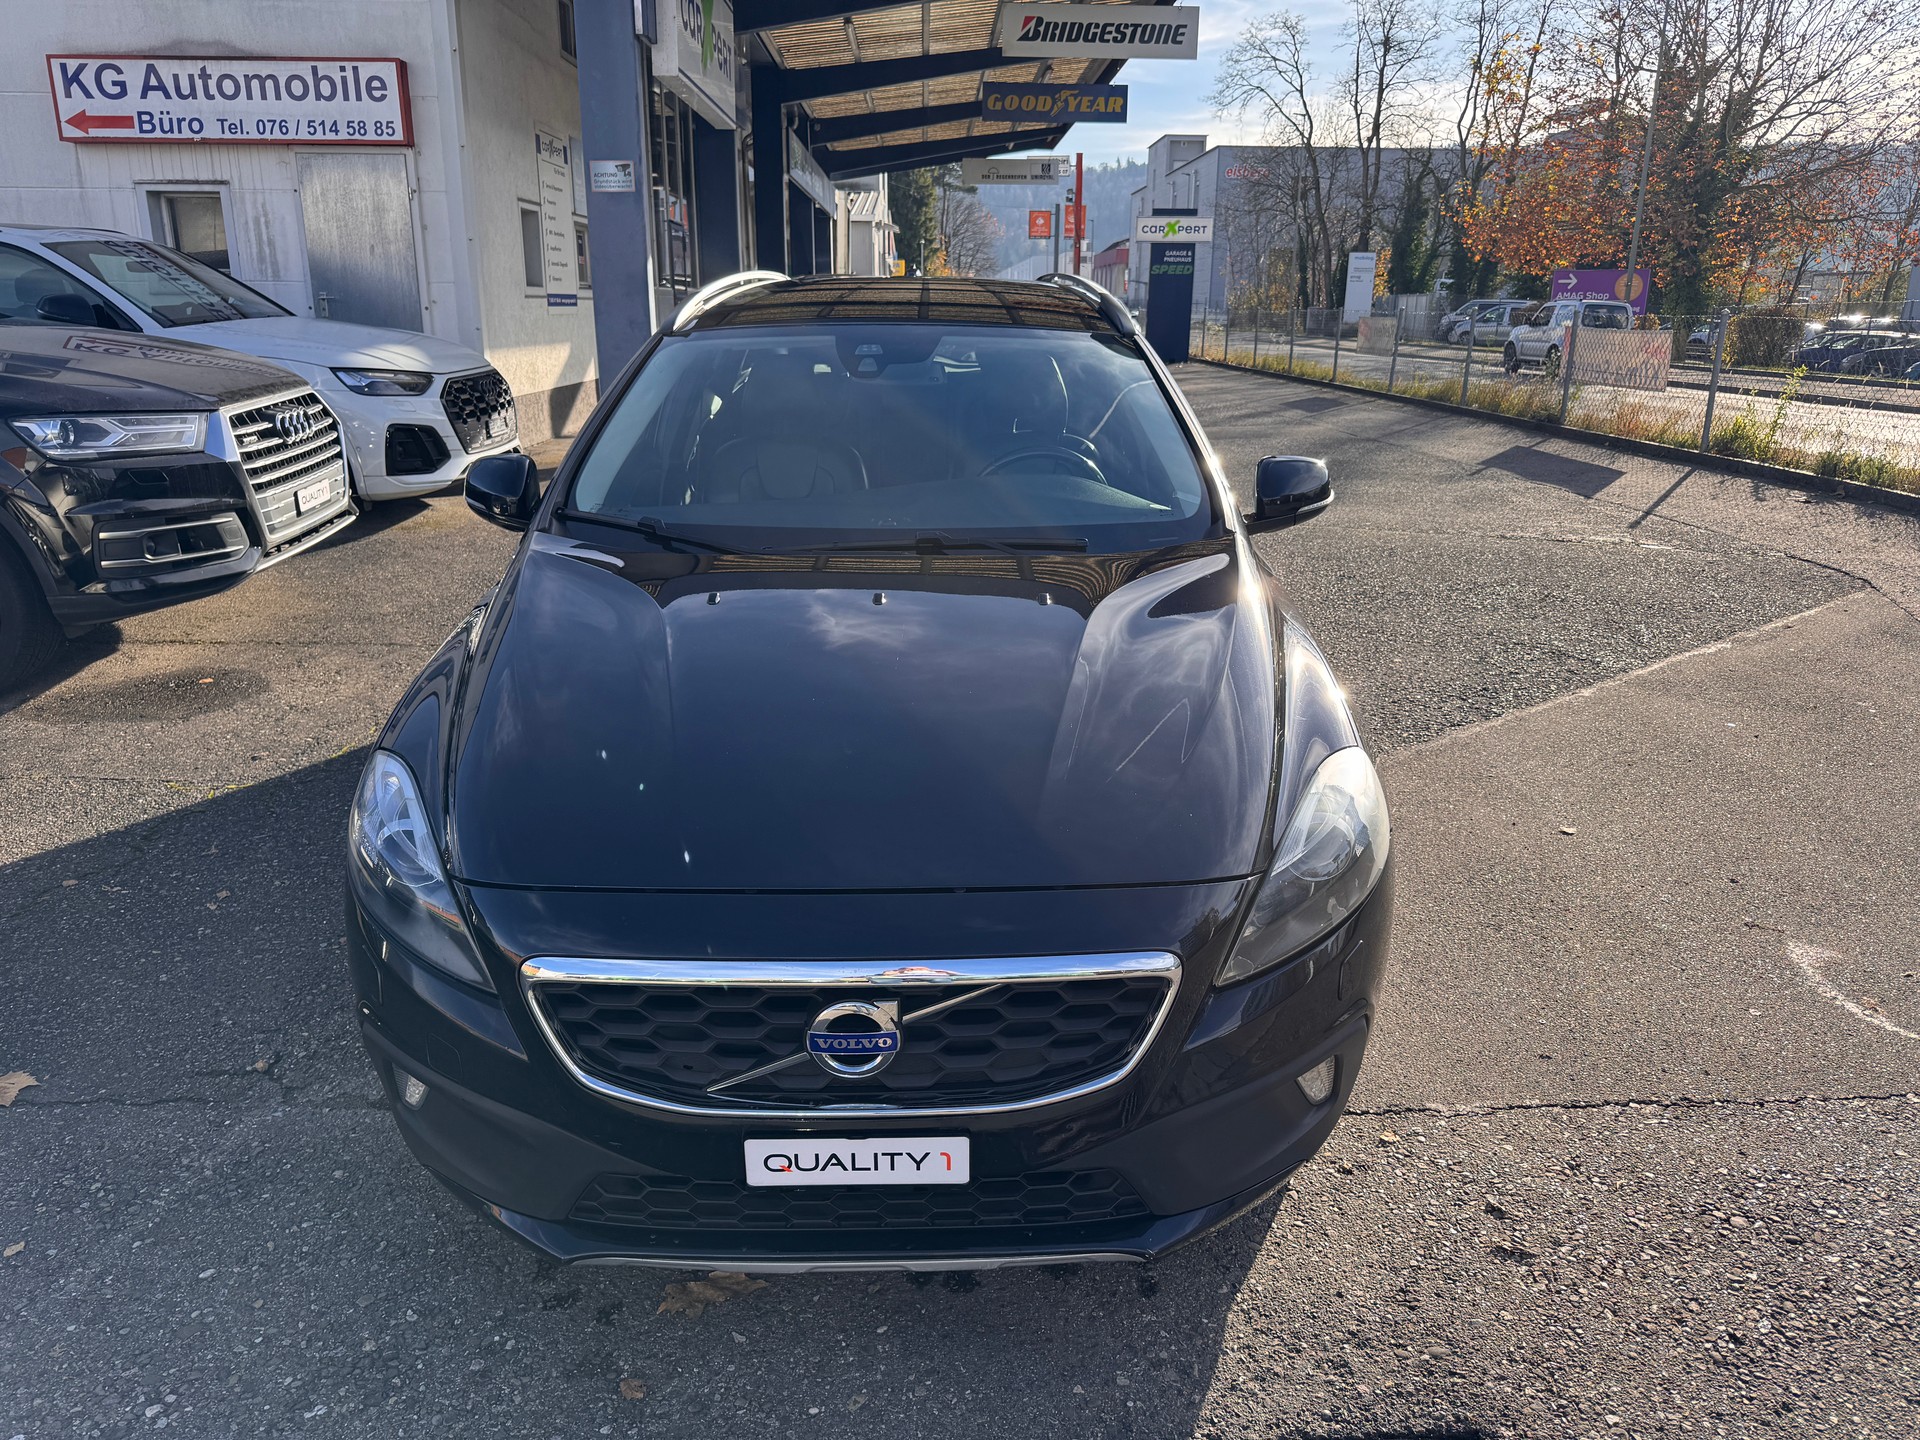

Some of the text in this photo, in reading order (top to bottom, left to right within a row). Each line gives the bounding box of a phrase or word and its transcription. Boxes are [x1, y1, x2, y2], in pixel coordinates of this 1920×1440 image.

[1016, 16, 1188, 45] BRIDGESTONE
[59, 63, 388, 103] KG Automobile
[136, 110, 396, 137] Büro Tel. 076 / 514 58 85
[1151, 265, 1193, 275] SPEED
[1557, 291, 1610, 300] AMAG Shop
[814, 1037, 893, 1049] VOLVO
[763, 1152, 952, 1173] QUALITY 1
